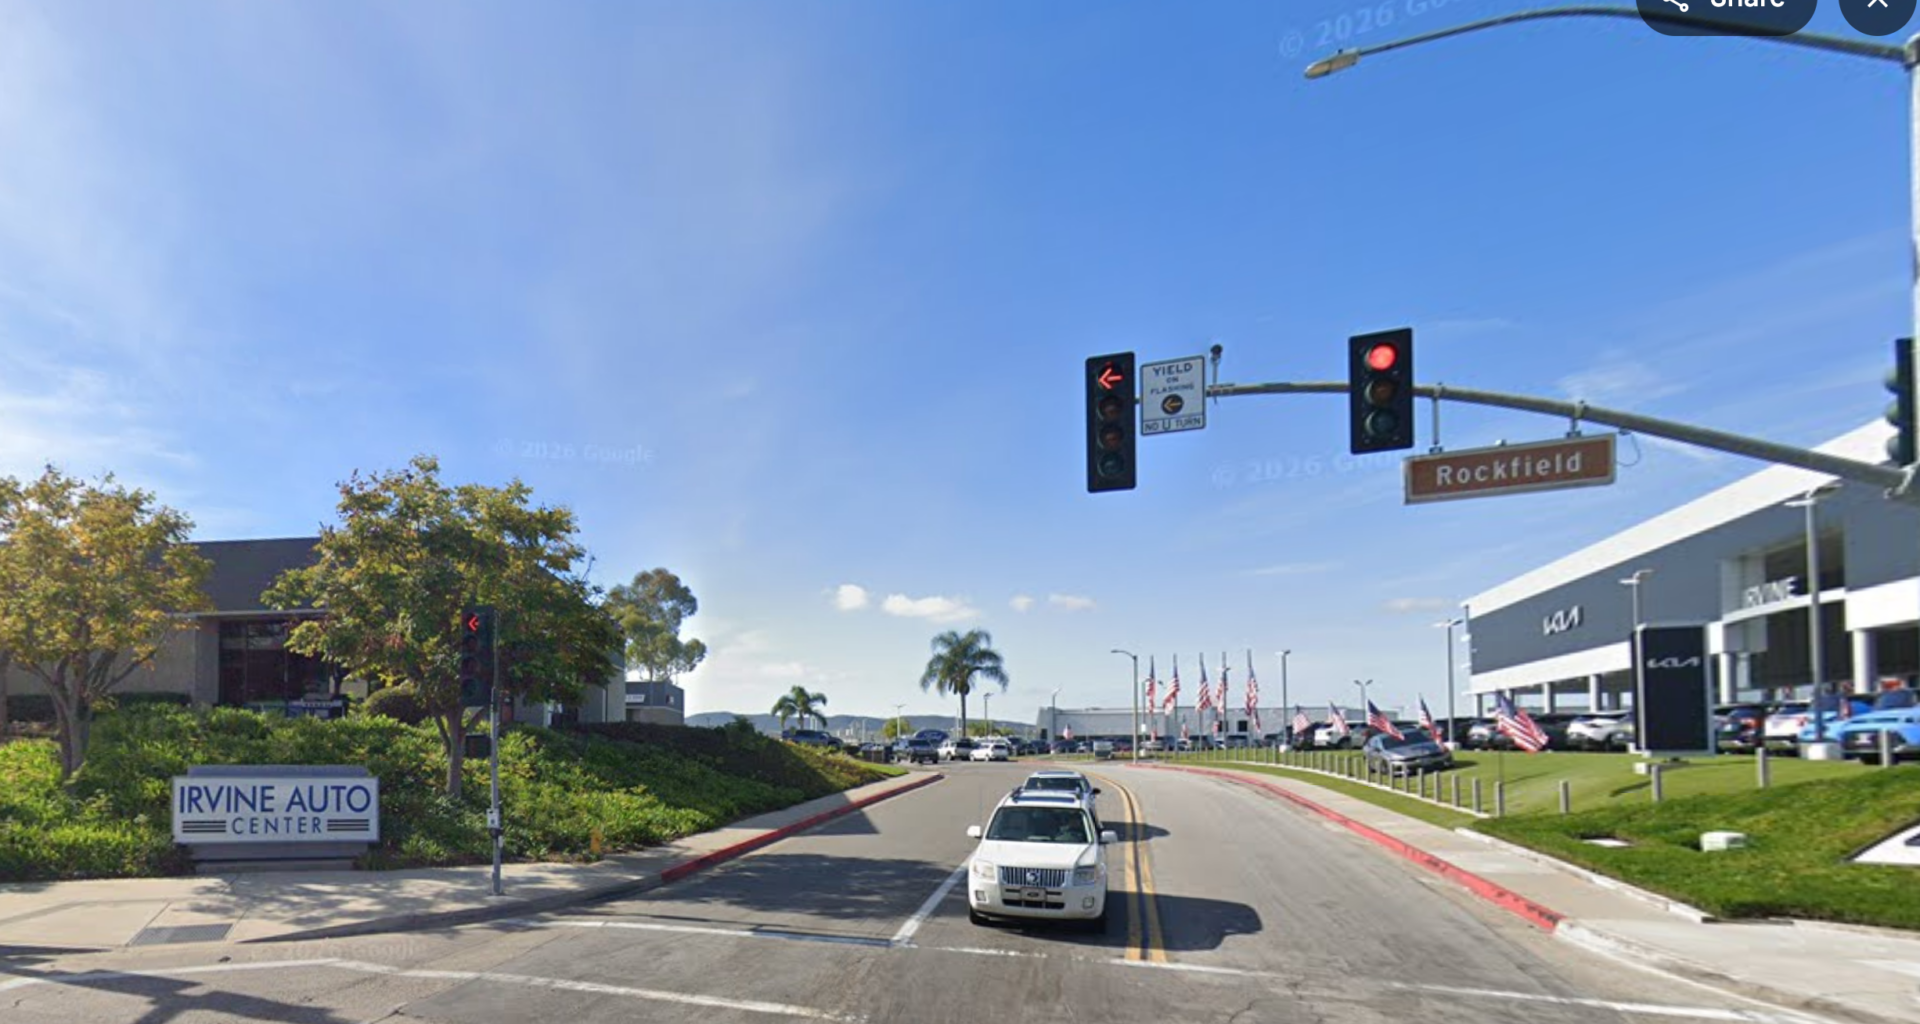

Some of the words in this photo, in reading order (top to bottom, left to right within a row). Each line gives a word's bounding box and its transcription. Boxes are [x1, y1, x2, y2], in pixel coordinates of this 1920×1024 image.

[1153, 362, 1193, 377] YIELD
[1145, 422, 1159, 432] NO
[1163, 418, 1171, 431] U
[1175, 417, 1201, 428] TURN
[1436, 452, 1582, 486] Rockfield
[1542, 605, 1580, 636] KIA
[179, 785, 275, 813] IRVINE
[286, 785, 371, 813] AUTO
[232, 816, 322, 834] CENTER
